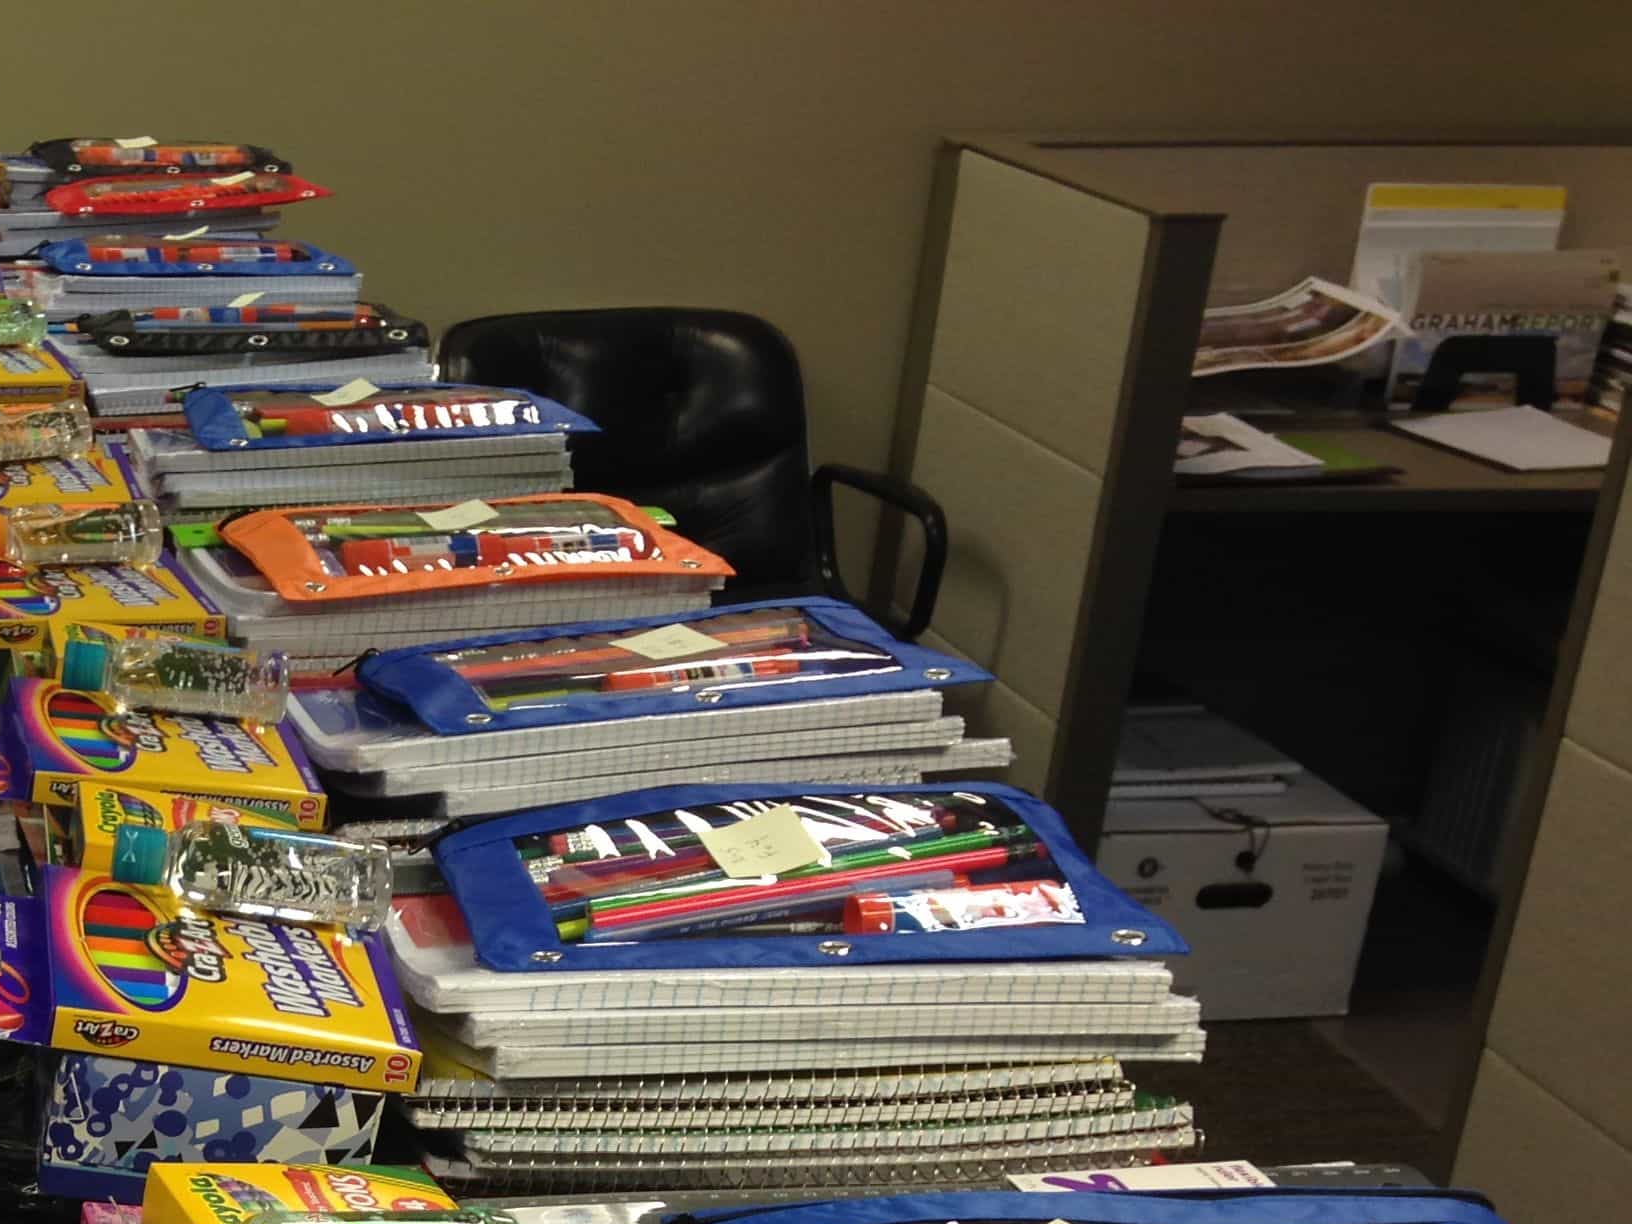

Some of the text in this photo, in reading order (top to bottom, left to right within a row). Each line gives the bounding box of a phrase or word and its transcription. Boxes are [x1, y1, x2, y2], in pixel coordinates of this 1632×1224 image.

[282, 924, 364, 1008] Markers
[211, 1038, 375, 1073] Assorted Markers
[384, 1054, 412, 1084] 10
